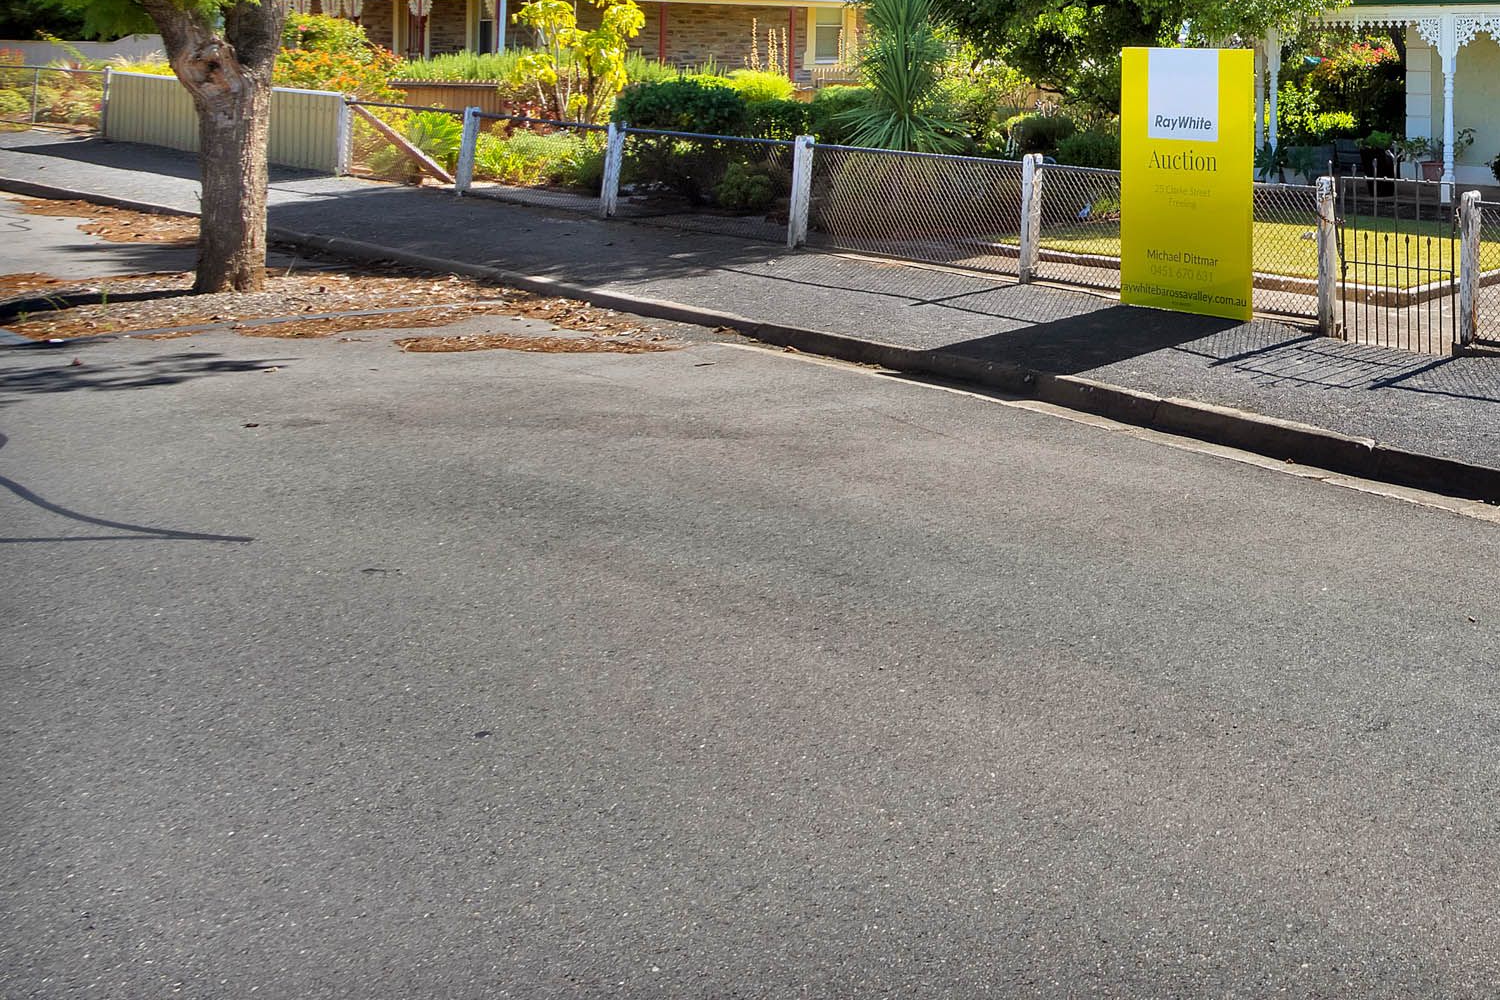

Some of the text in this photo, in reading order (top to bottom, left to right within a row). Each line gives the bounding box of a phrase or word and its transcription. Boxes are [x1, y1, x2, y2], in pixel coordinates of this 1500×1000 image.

[1148, 149, 1217, 172] Auction
[1147, 249, 1218, 268] Michael Dittmar
[1151, 264, 1173, 277] 0451
[1121, 282, 1247, 307] raywhitebarossavalley.com.au
